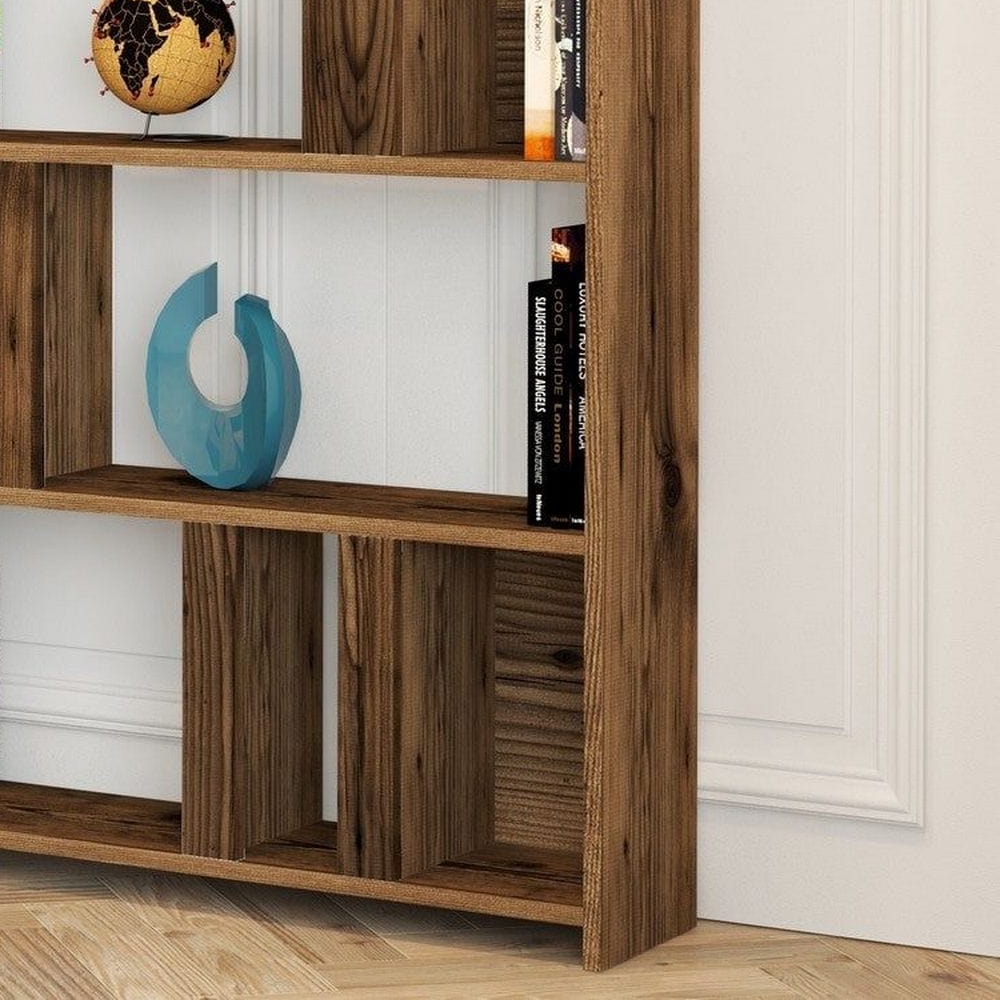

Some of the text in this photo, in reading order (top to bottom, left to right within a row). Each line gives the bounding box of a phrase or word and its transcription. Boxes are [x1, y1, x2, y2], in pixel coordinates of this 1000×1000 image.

[534, 5, 544, 52] Nicholson
[535, 296, 547, 413] SLAUGHTERHOUSE ANGELS
[553, 288, 564, 464] COOL GUIDE London
